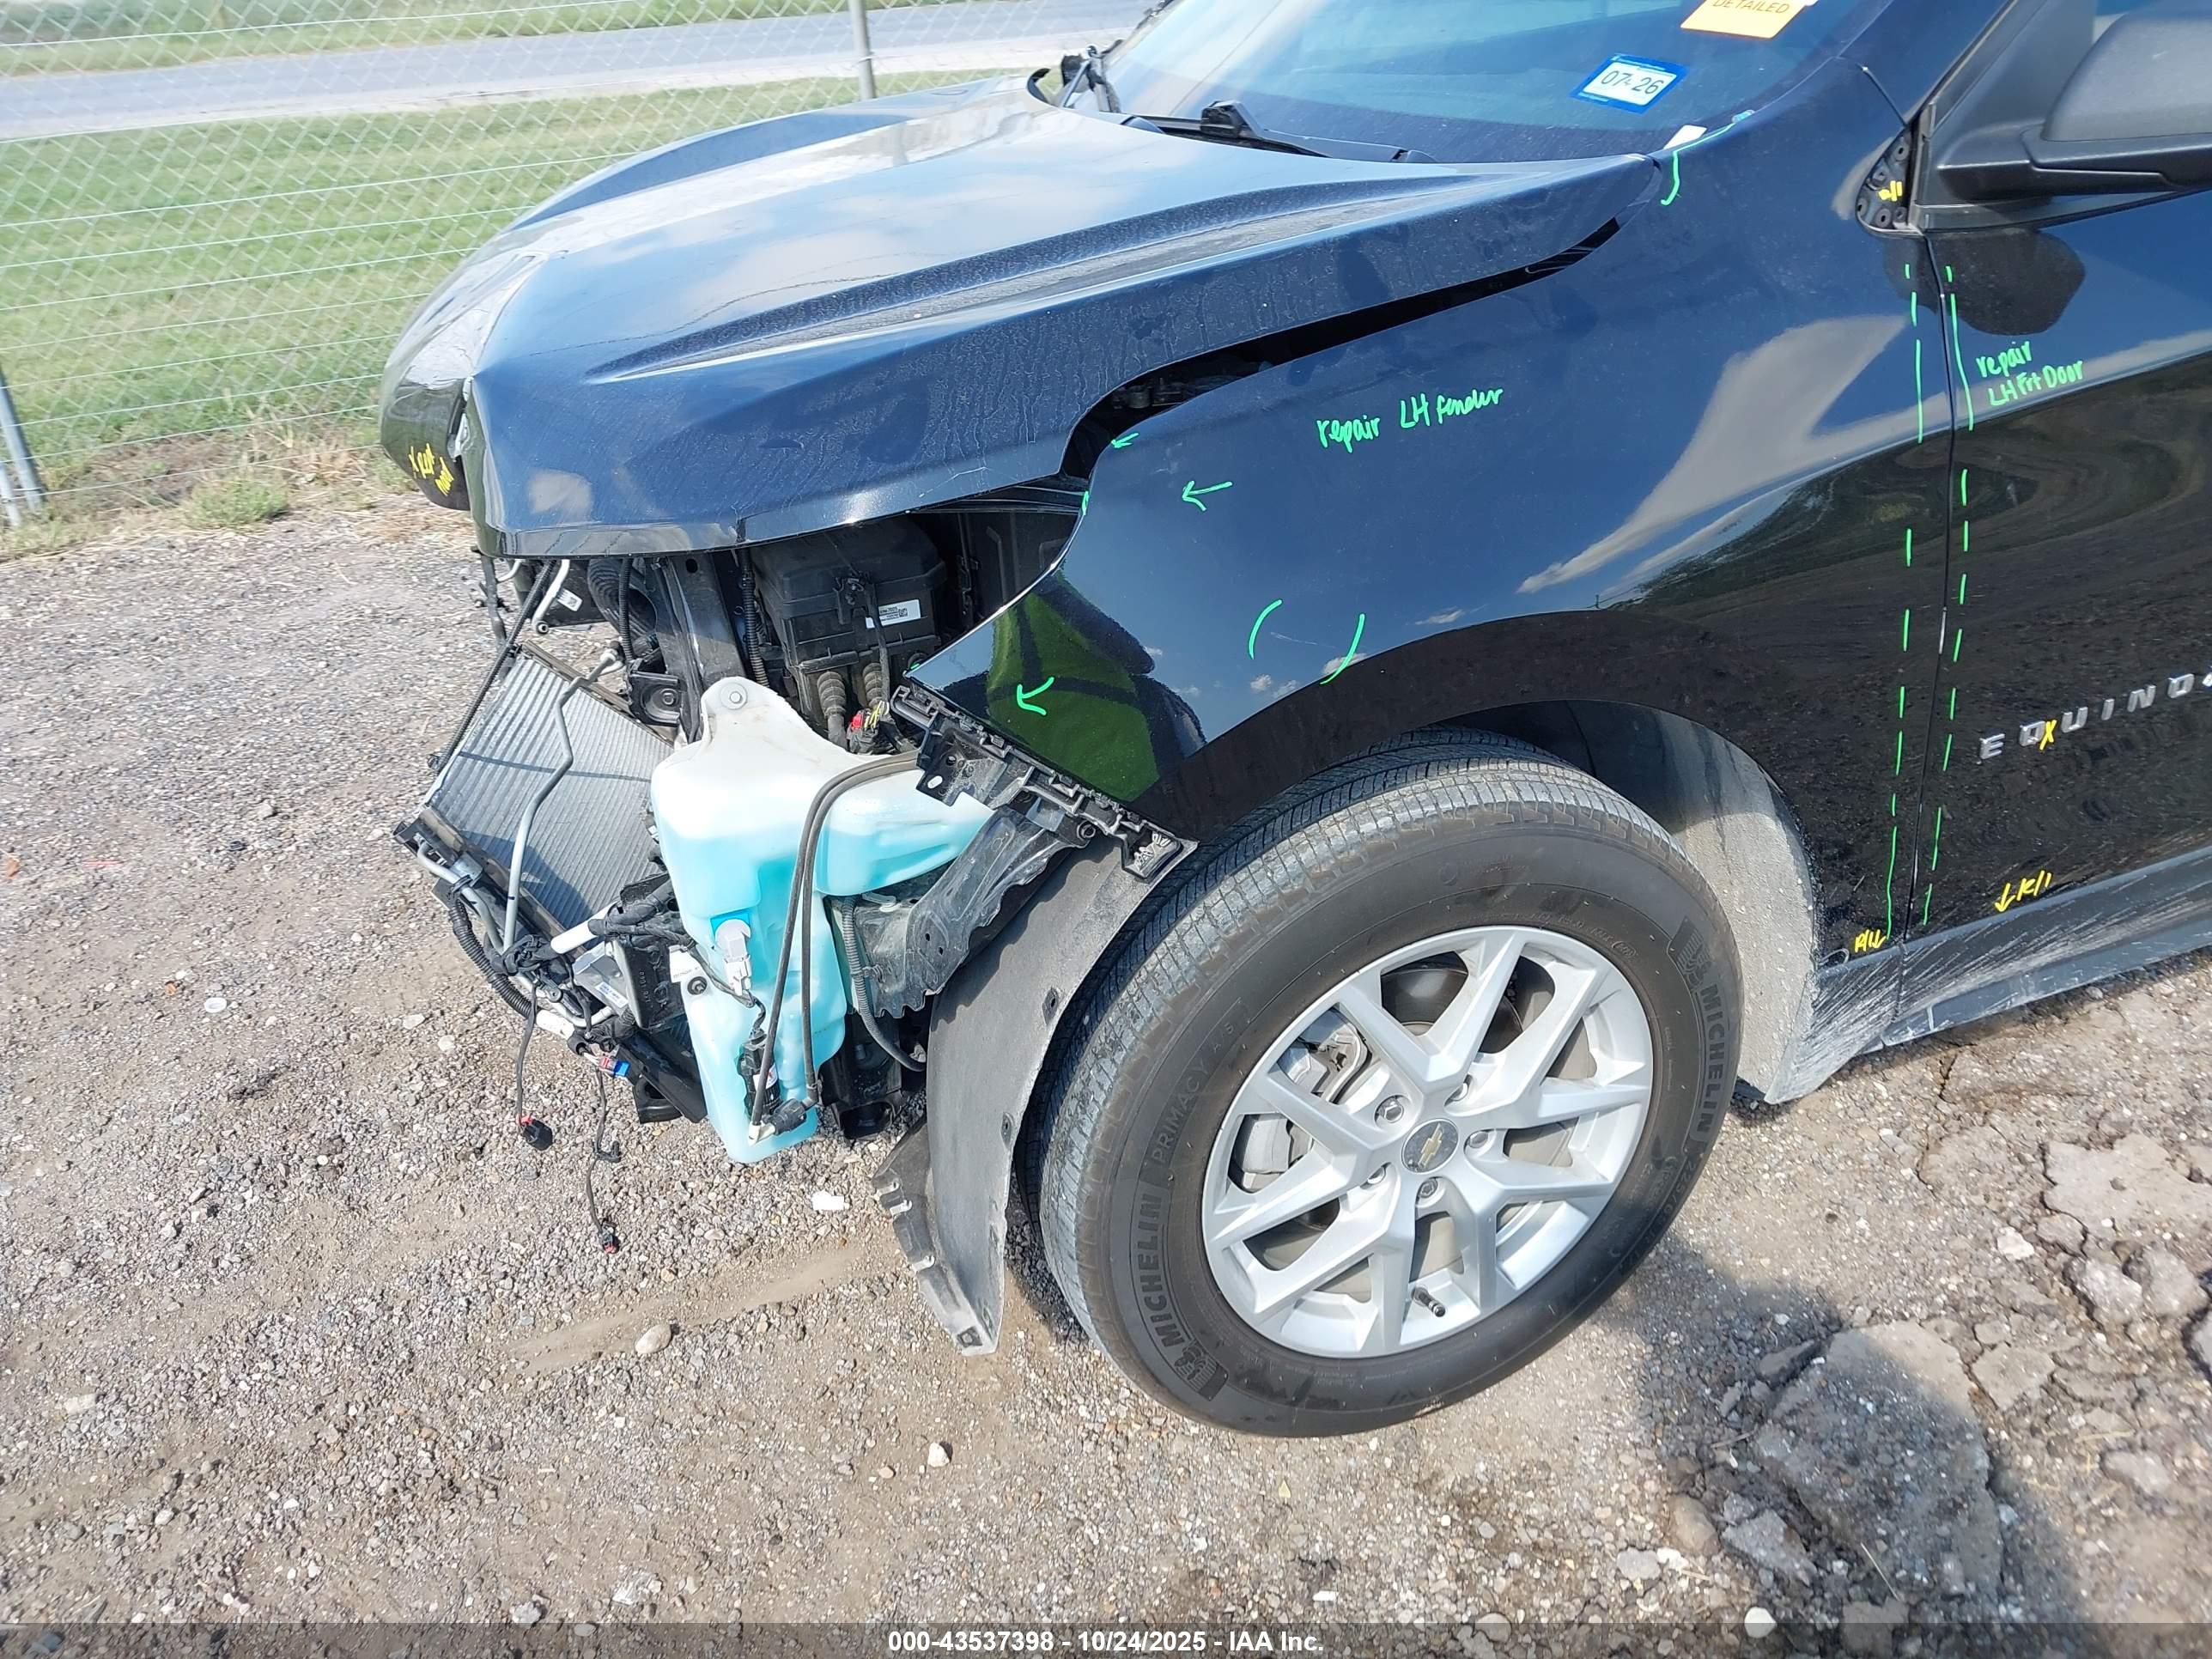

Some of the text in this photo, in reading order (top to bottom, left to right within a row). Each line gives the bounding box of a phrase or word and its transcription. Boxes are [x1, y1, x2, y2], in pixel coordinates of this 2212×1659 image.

[1712, 0, 1790, 14] DETAILED
[1601, 70, 1665, 95] 07 26
[1976, 340, 2033, 378] repair
[1987, 379, 2019, 406] LH
[2042, 360, 2083, 388] Door
[1316, 388, 1504, 453] repair LH fender
[1978, 672, 2212, 761] EQUINO
[1696, 986, 1726, 1133] MICHELIN
[1152, 1058, 1209, 1164] PRIMACY
[1138, 1193, 1186, 1348] MICHELIN
